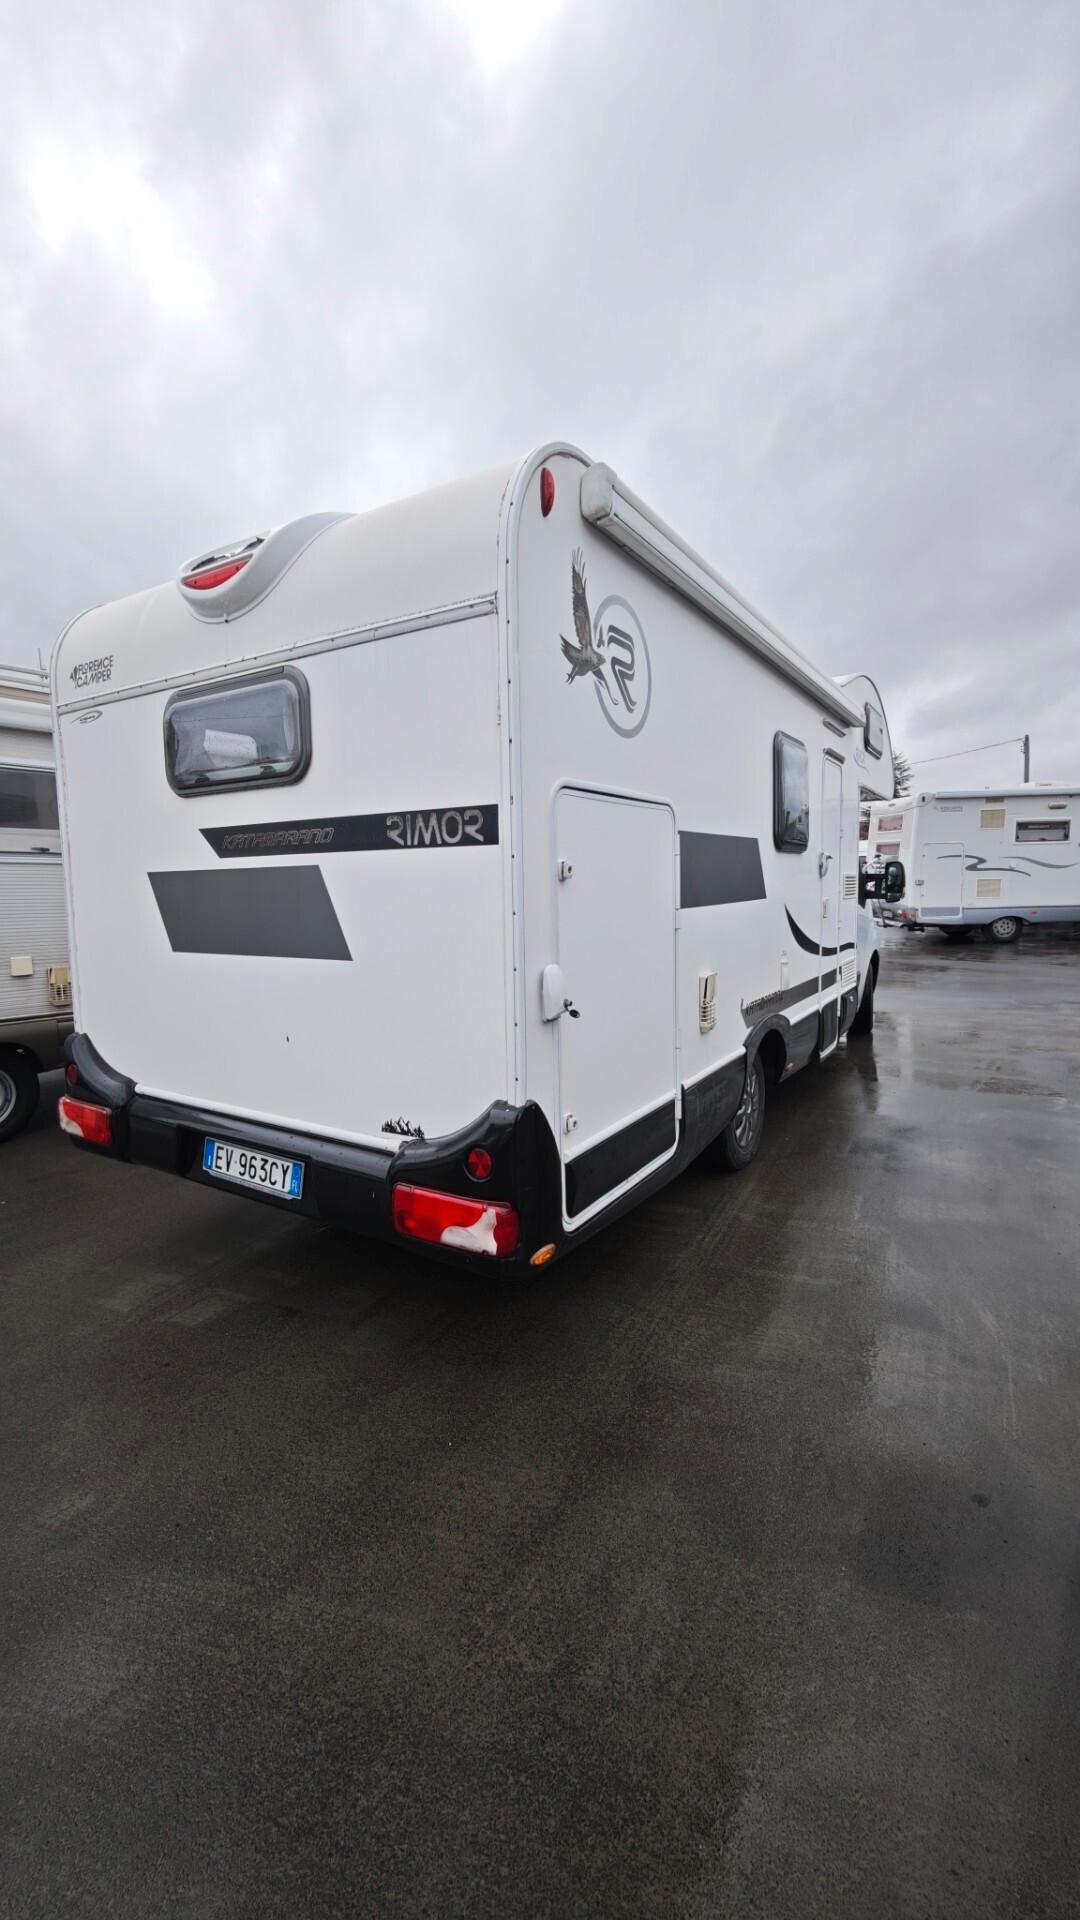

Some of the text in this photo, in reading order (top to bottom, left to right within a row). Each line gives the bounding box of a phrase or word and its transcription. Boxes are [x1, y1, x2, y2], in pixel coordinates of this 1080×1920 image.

[76, 668, 112, 688] CAMPER
[77, 655, 114, 675] FLORENCE
[386, 809, 484, 847] RIMOR
[215, 1145, 233, 1173] EV
[238, 1153, 290, 1189] 963CY
